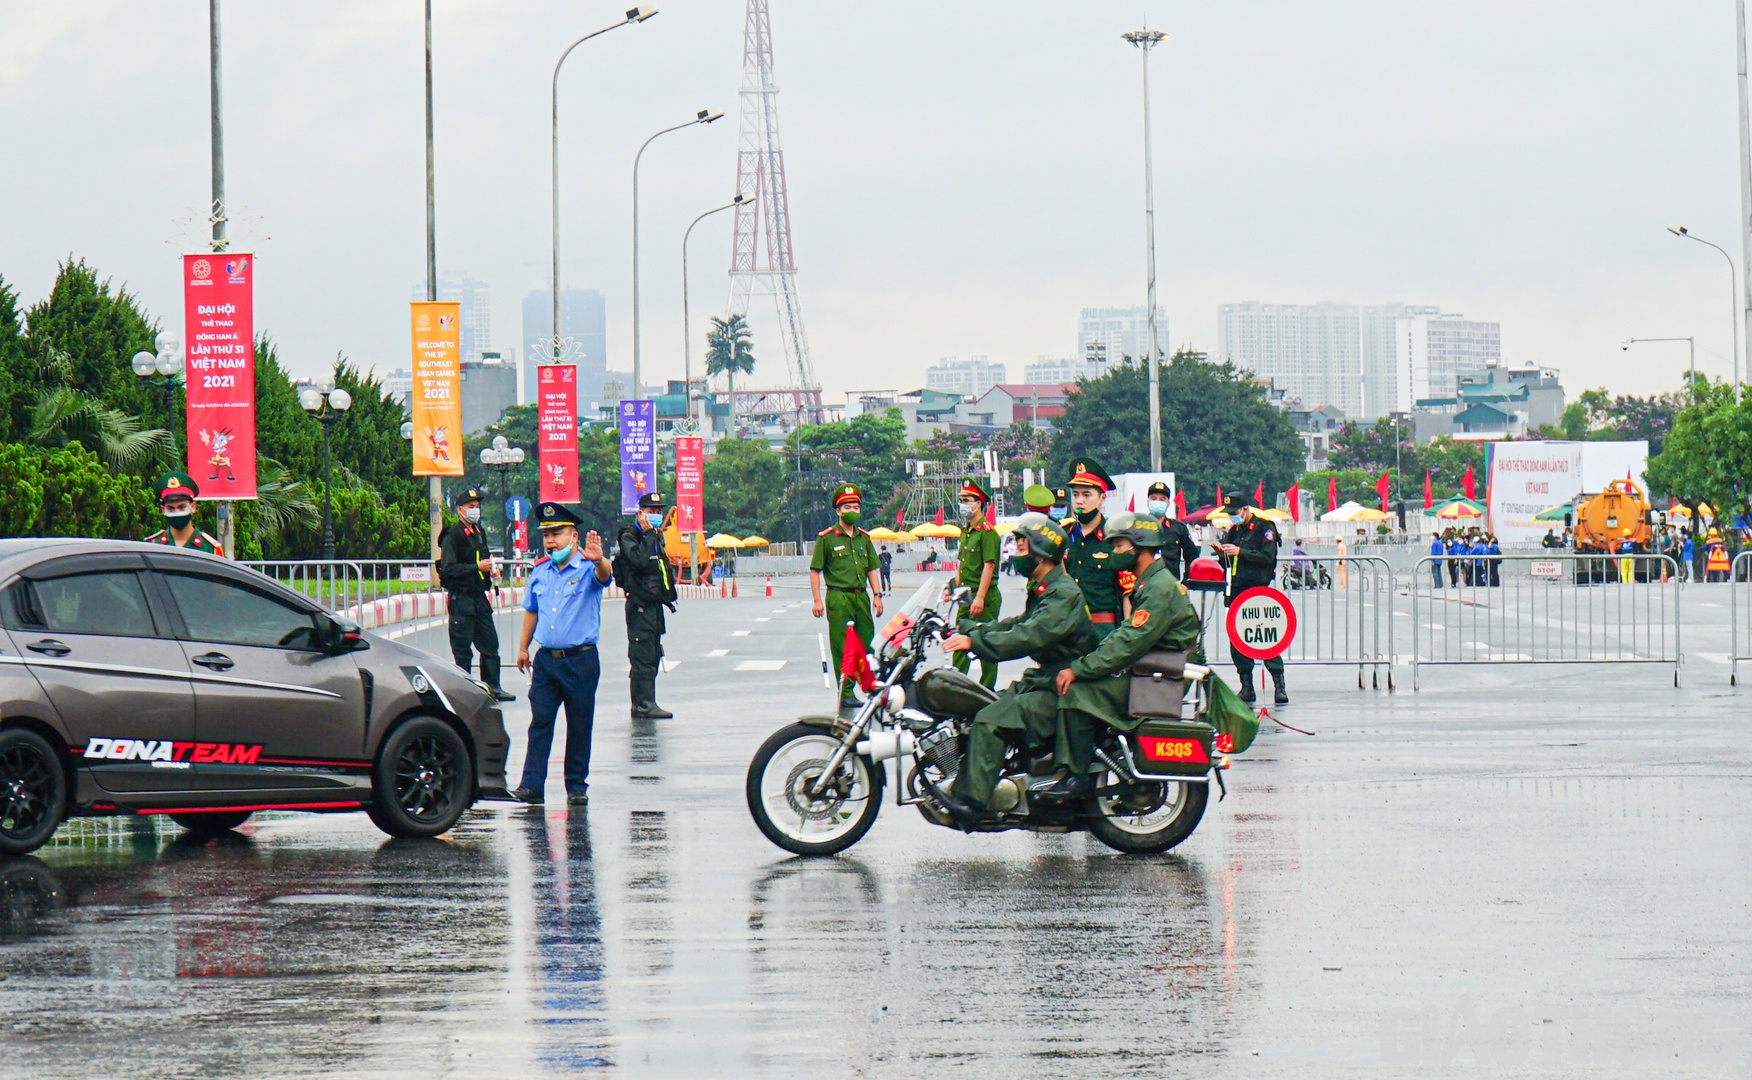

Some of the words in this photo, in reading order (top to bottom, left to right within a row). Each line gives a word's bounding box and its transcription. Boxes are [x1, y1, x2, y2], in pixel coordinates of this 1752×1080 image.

[198, 305, 215, 317] ĐẠI
[217, 303, 235, 316] HỘI
[191, 342, 210, 354] LẦN
[211, 343, 233, 354] THỨ
[234, 345, 244, 354] 31
[191, 356, 217, 371] VIỆT
[218, 358, 245, 369] NAM
[203, 376, 235, 388] 2021
[424, 389, 450, 399] 2021
[548, 432, 567, 441] 2021
[1242, 607, 1260, 619] KHU
[1263, 605, 1281, 621] VỰC
[1244, 623, 1278, 643] CẤM
[1155, 741, 1193, 758] KSQS
